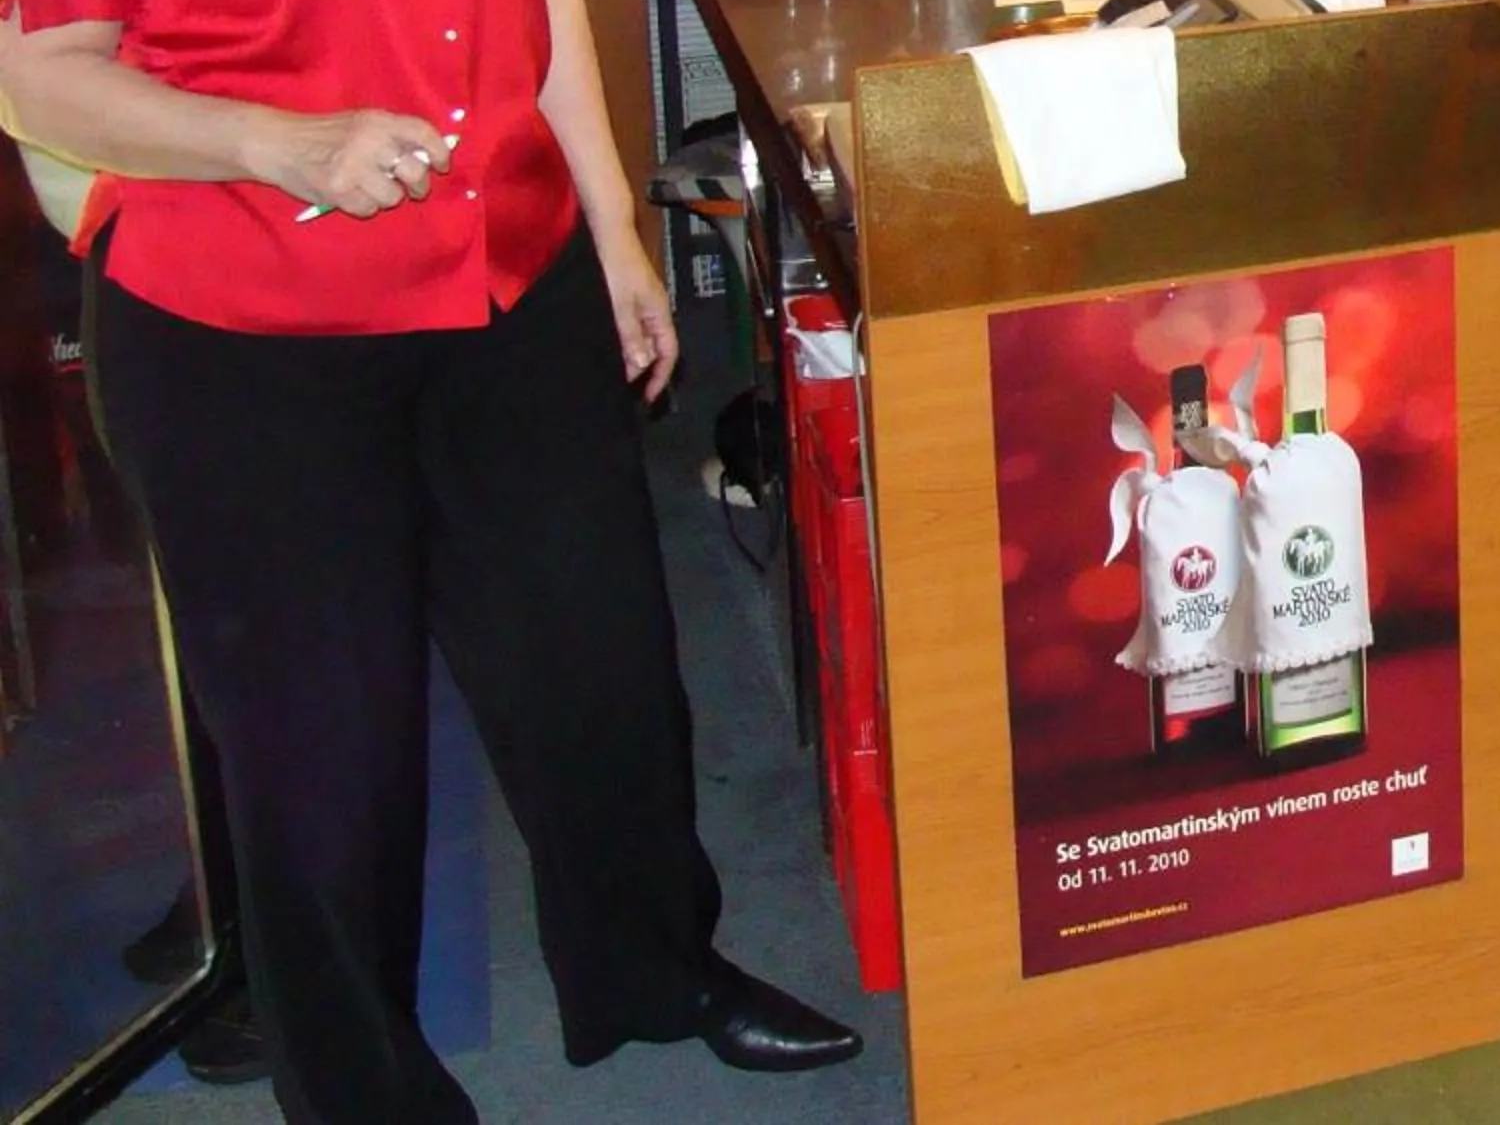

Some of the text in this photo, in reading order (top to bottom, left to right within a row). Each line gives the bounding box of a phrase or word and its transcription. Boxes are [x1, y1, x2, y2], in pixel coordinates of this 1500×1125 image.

[1291, 578, 1335, 601] SVATO
[1056, 764, 1428, 864] Se Svatomartinským vínem roste chuť
[1058, 848, 1190, 891] Od 11. 11. 2010
